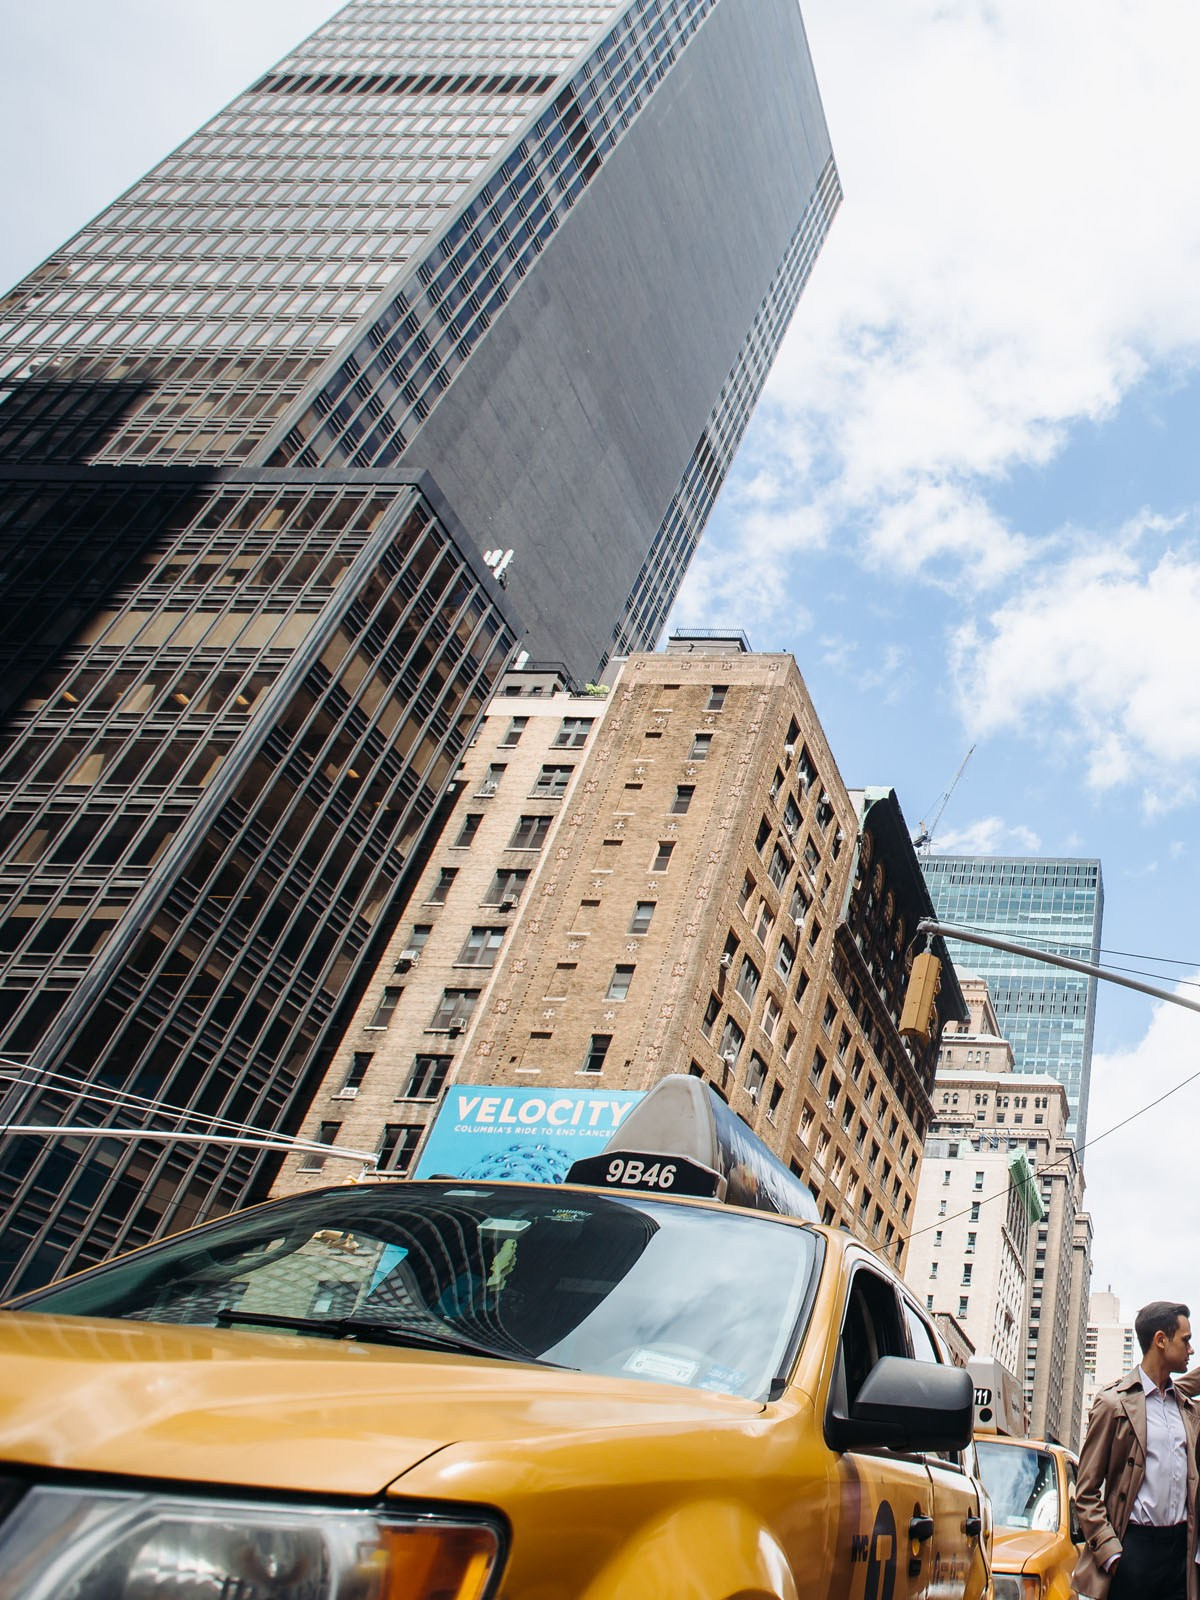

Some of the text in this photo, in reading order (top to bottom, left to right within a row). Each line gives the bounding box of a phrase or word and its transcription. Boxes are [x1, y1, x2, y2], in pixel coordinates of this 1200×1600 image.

[458, 1096, 633, 1126] VELOCITY
[454, 1124, 511, 1134] COLUMBIA'S
[515, 1127, 537, 1135] RIDE
[541, 1128, 553, 1136] TO
[556, 1129, 576, 1137] END
[606, 1159, 677, 1189] 9B46
[974, 1389, 988, 1404] 11
